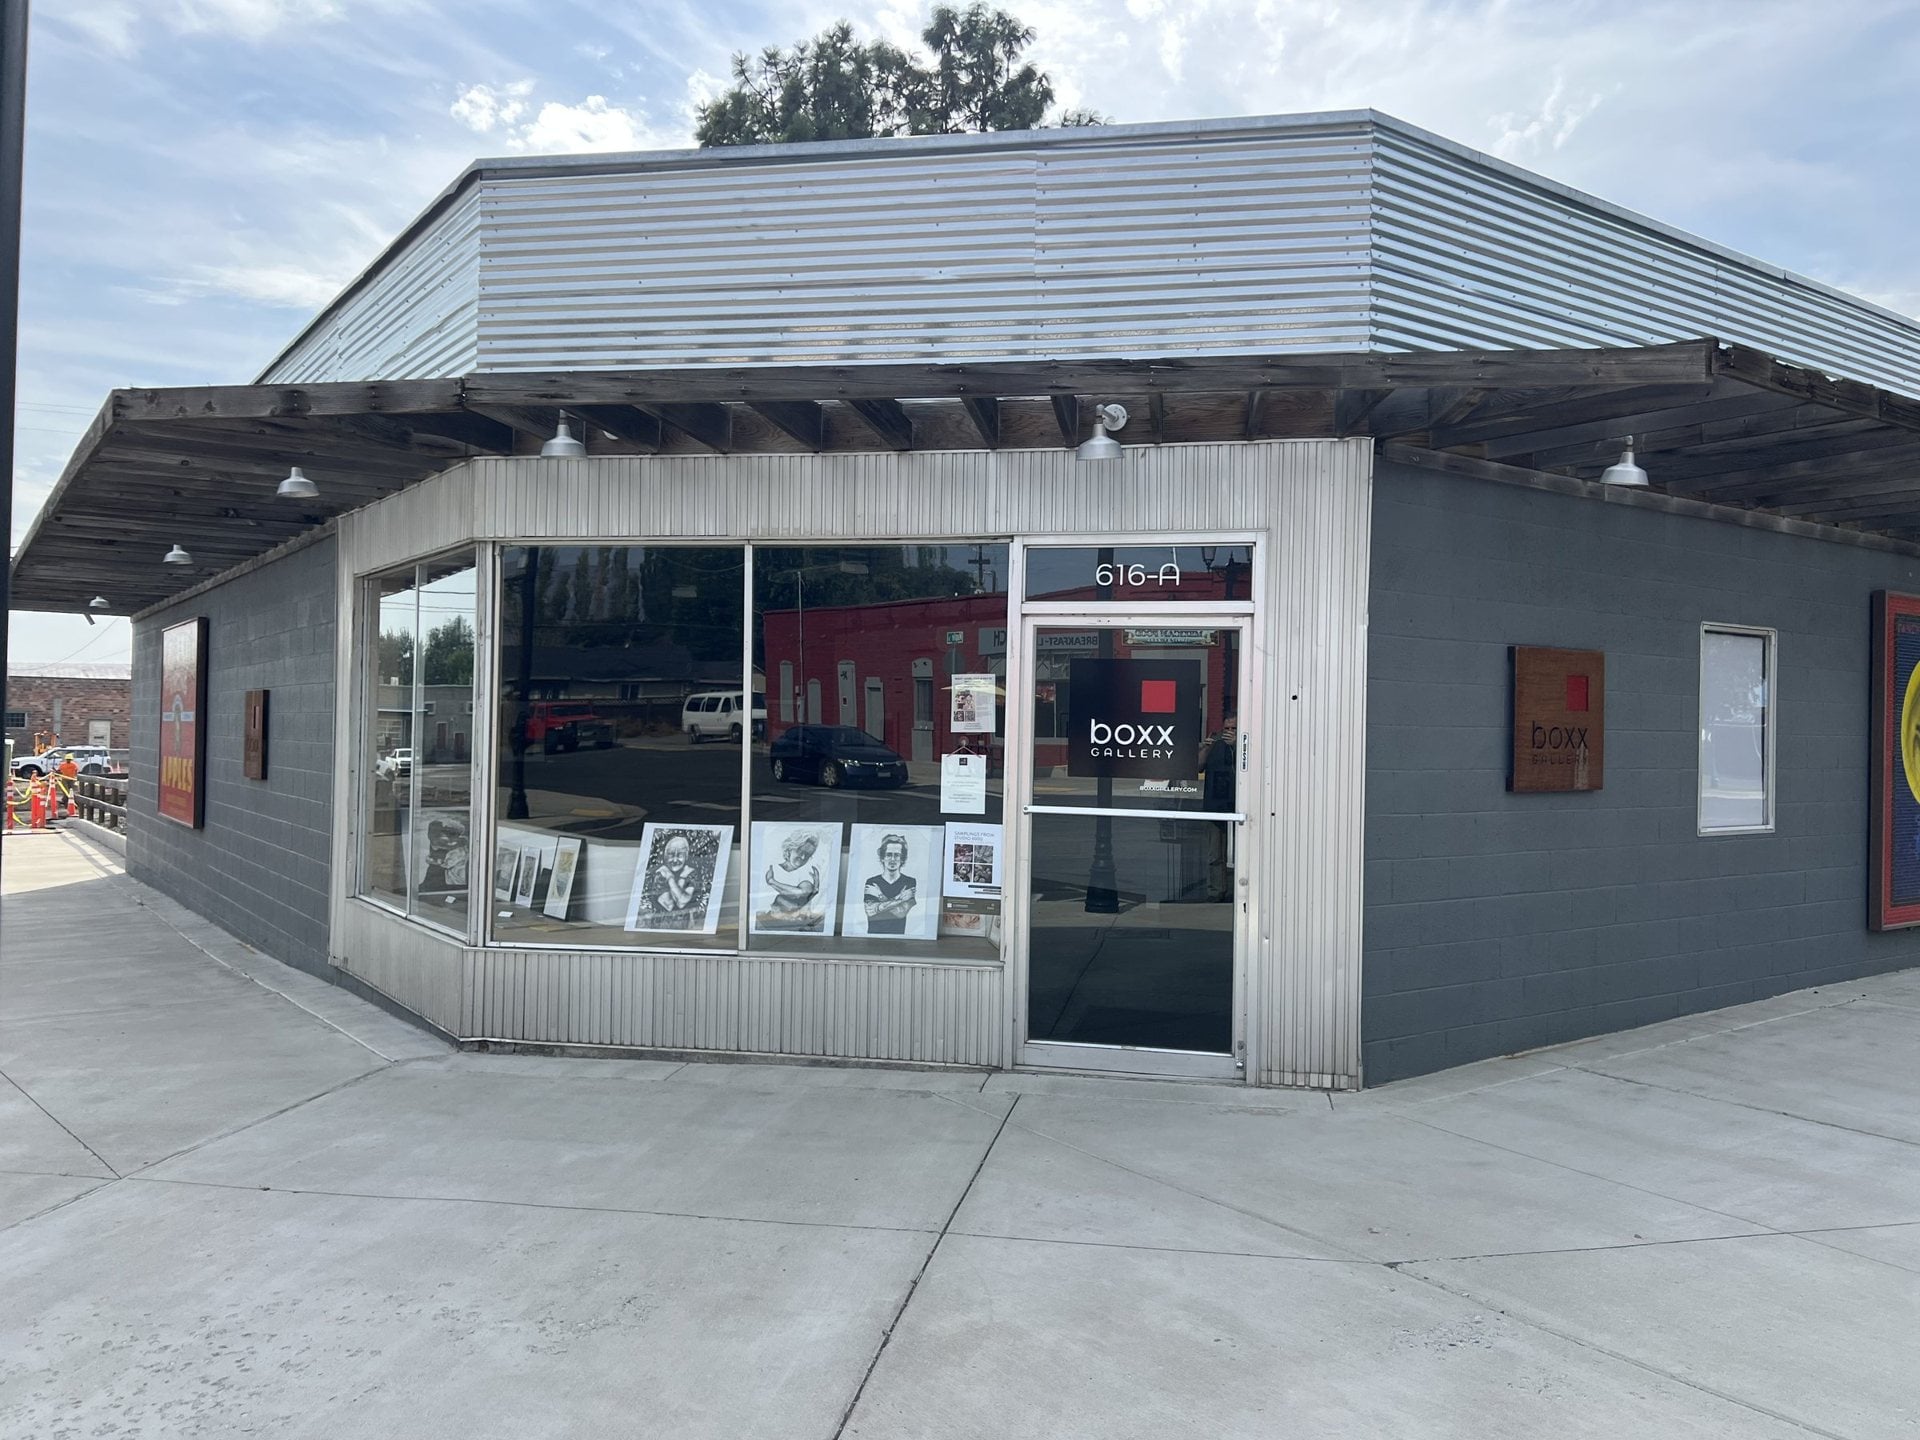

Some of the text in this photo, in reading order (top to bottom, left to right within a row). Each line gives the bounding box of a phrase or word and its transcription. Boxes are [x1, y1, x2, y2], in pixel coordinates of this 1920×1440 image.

[1095, 563, 1180, 587] 616-A
[1090, 719, 1175, 746] boxx
[1531, 719, 1589, 750] boxx
[1091, 747, 1174, 759] GALLERY
[162, 756, 193, 793] APPLES
[1139, 785, 1198, 793] BOXXGALLERY.COM
